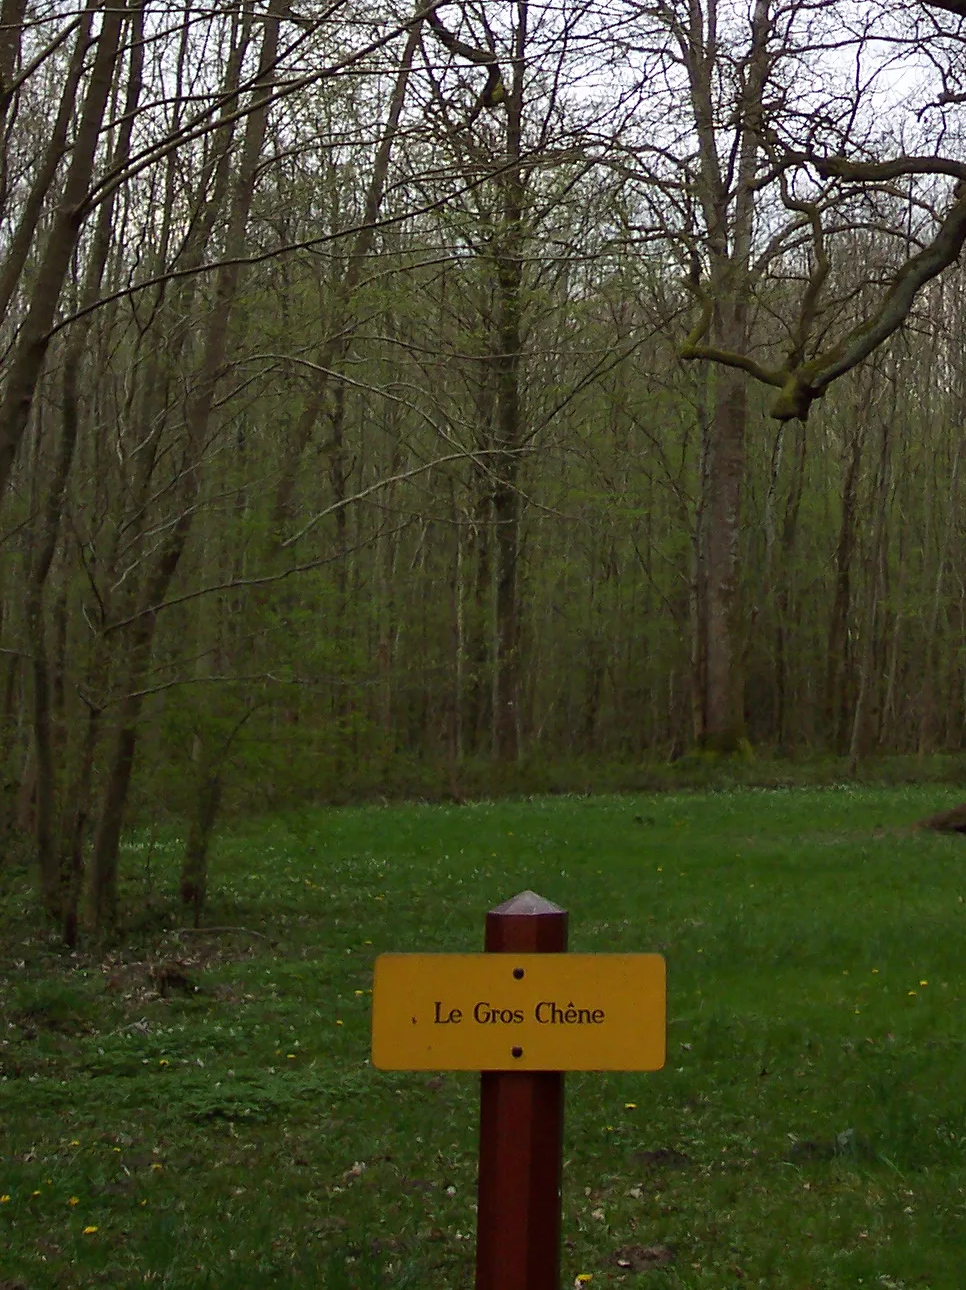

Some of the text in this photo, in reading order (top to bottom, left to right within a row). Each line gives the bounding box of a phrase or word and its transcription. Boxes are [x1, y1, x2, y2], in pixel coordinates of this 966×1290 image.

[433, 1001, 606, 1025] Le Gros Chêne
